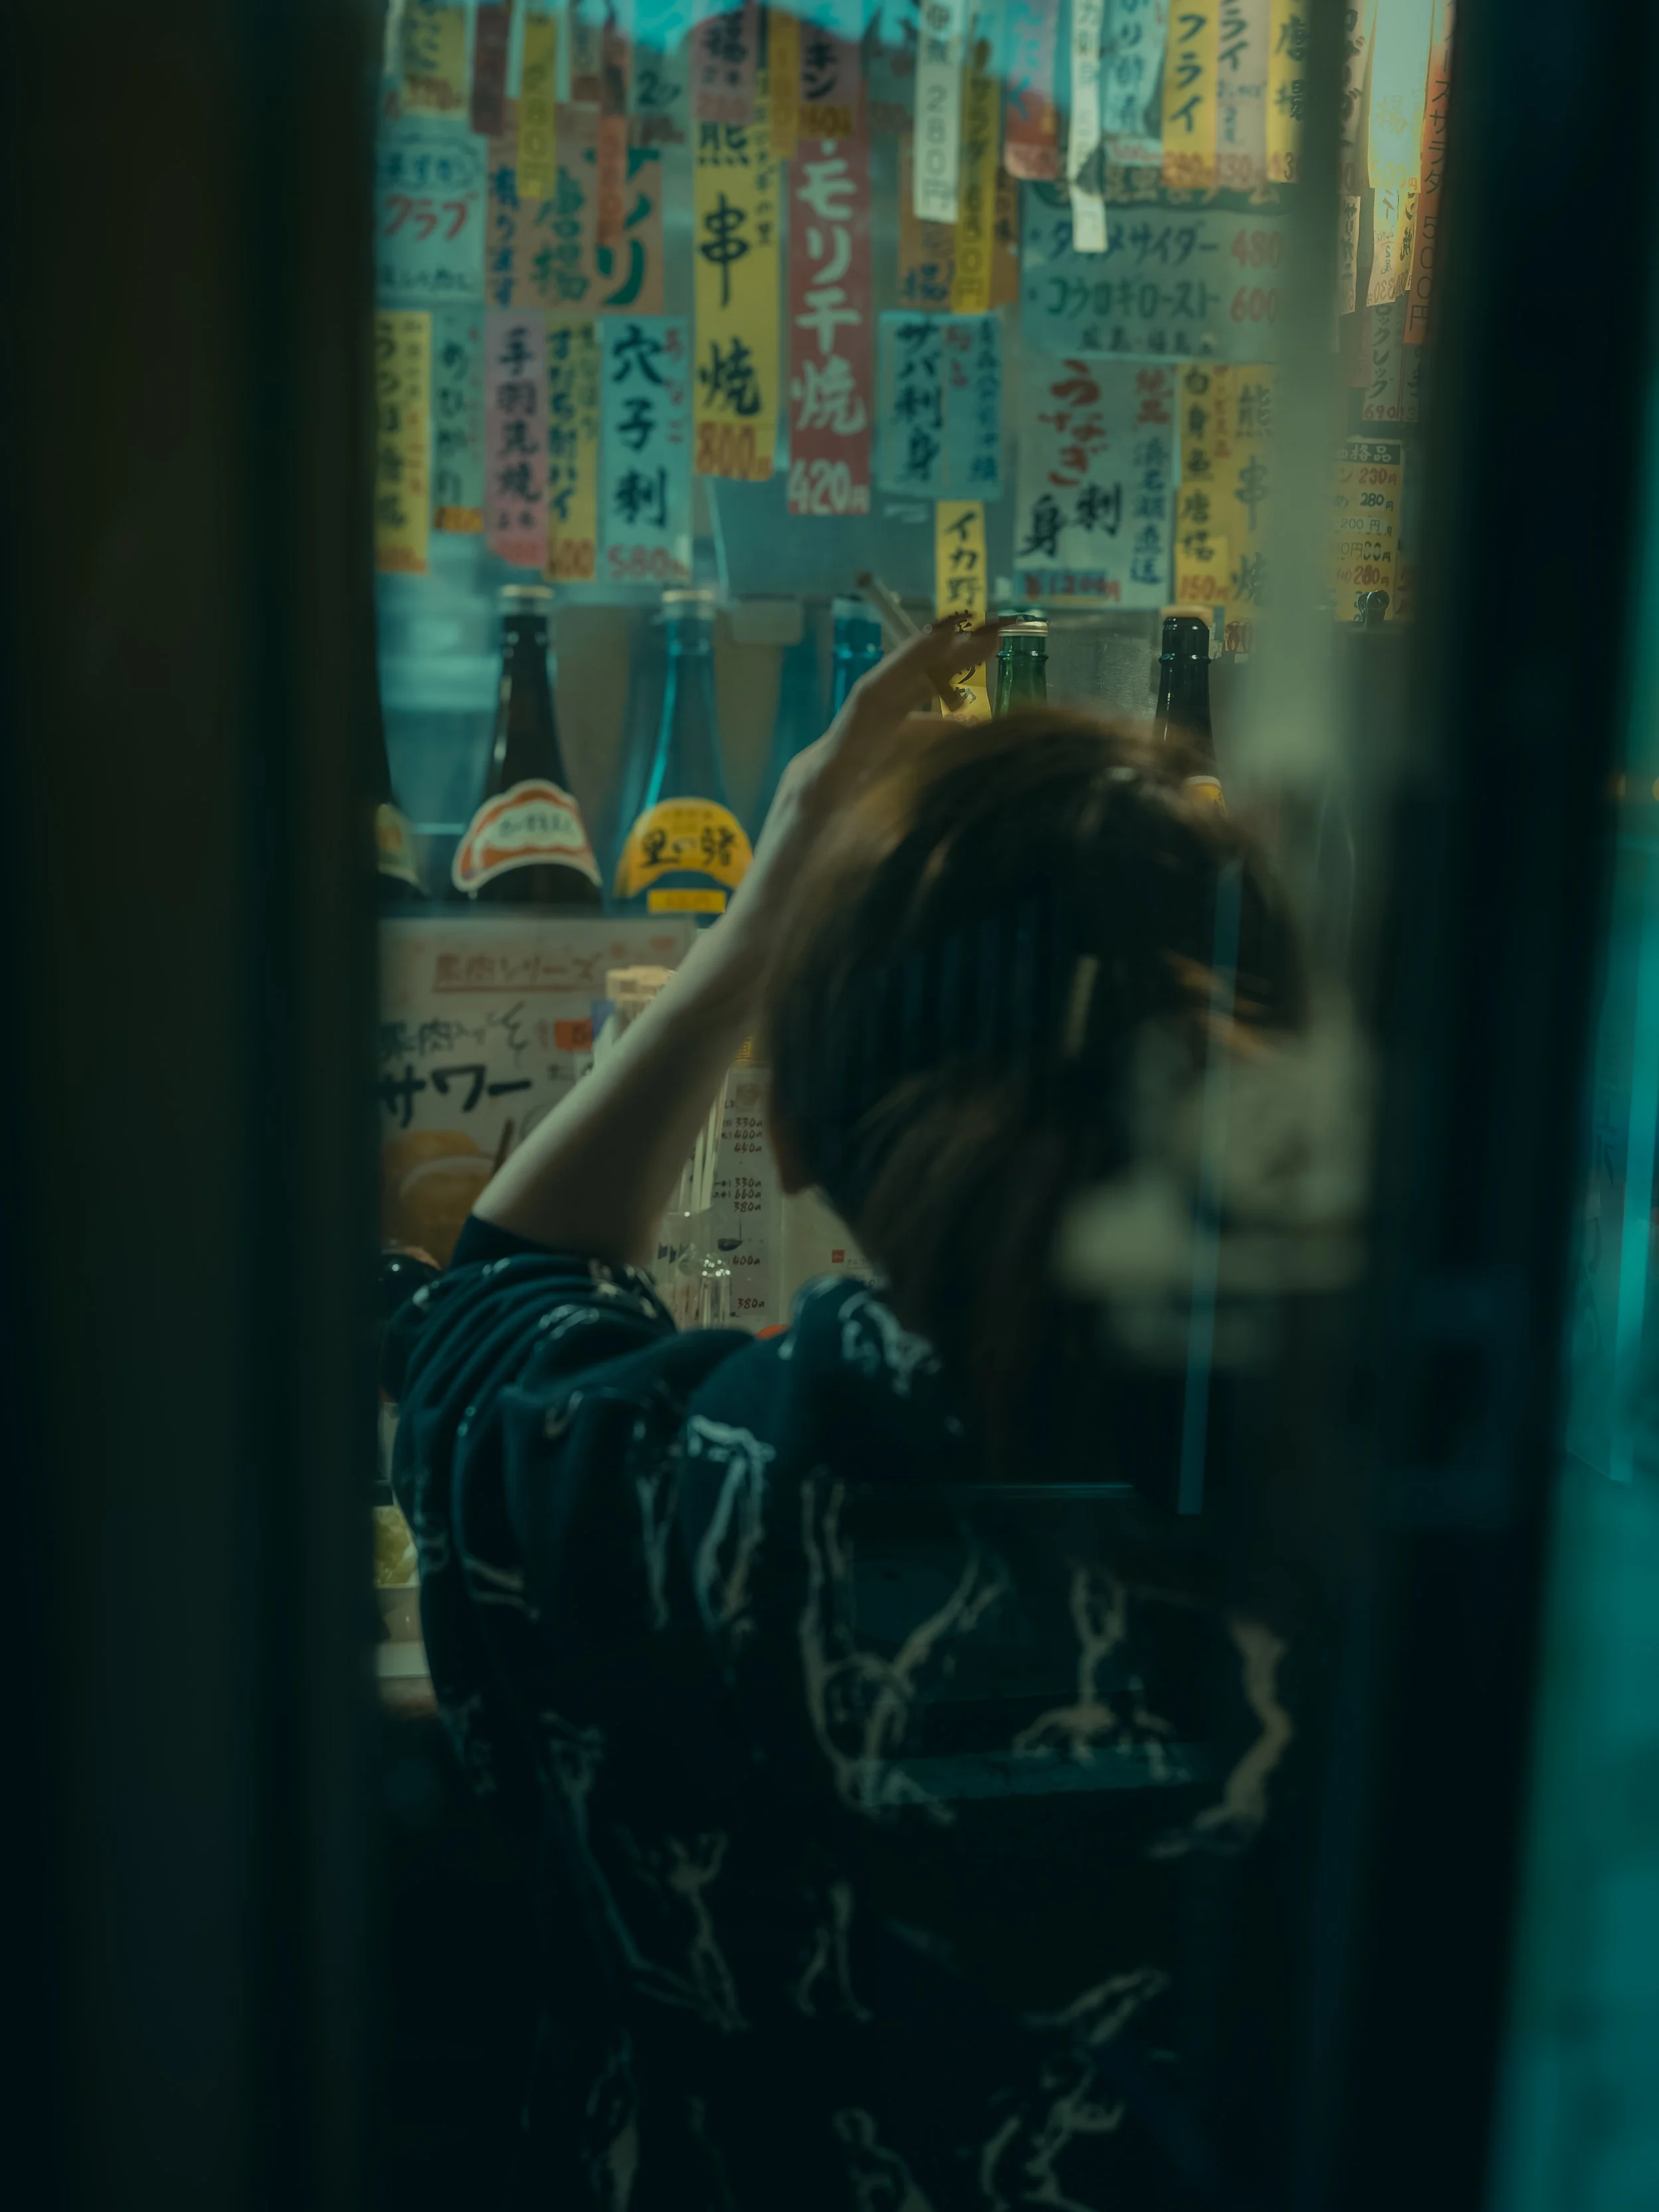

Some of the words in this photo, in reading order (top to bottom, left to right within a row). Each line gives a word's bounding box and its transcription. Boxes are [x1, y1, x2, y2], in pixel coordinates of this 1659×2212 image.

[1169, 13, 1208, 133] フライ
[1050, 218, 1220, 265] タメサイダー
[787, 158, 869, 437] モリ干焼
[611, 323, 669, 530] 穴子刺
[1038, 358, 1108, 488] うなぎ
[788, 458, 871, 515] 420円
[1358, 467, 1397, 486] 230円
[1360, 491, 1394, 512] 280円
[1179, 573, 1229, 601] 150円
[376, 1062, 533, 1130] サワー
